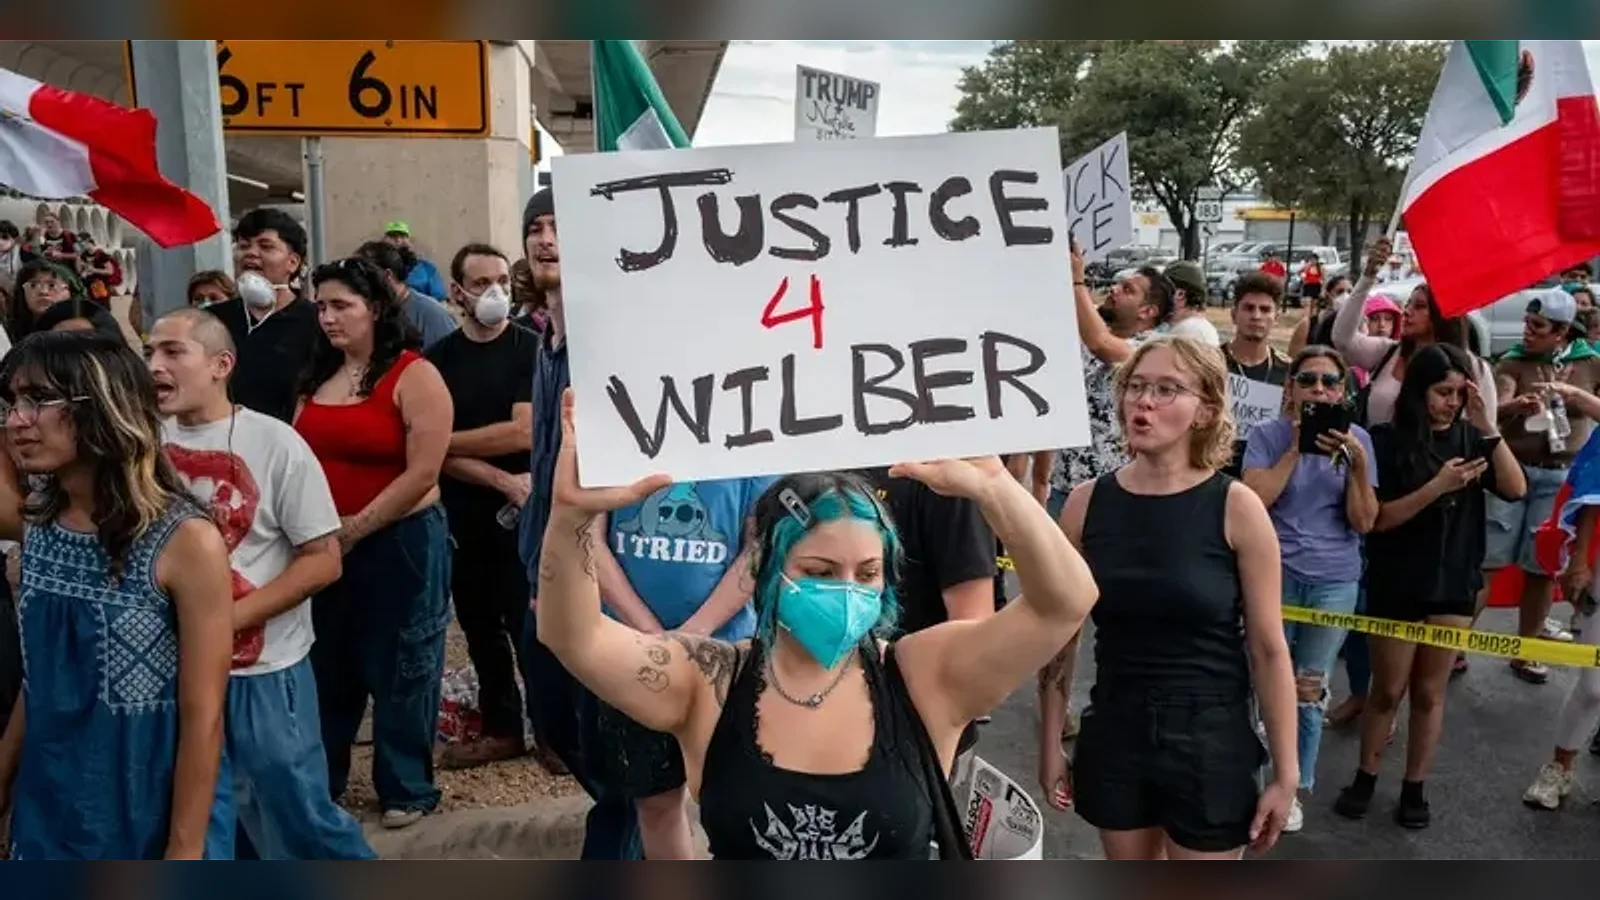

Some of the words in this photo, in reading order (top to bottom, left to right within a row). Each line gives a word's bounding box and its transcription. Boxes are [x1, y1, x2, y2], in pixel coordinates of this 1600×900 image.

[802, 69, 875, 110] TRUMP
[590, 168, 1053, 272] JUSTICE
[761, 274, 824, 349] 4
[606, 331, 1050, 459] WILBER
[1230, 376, 1249, 399] NO
[616, 532, 625, 554] I
[630, 535, 728, 564] TRIED
